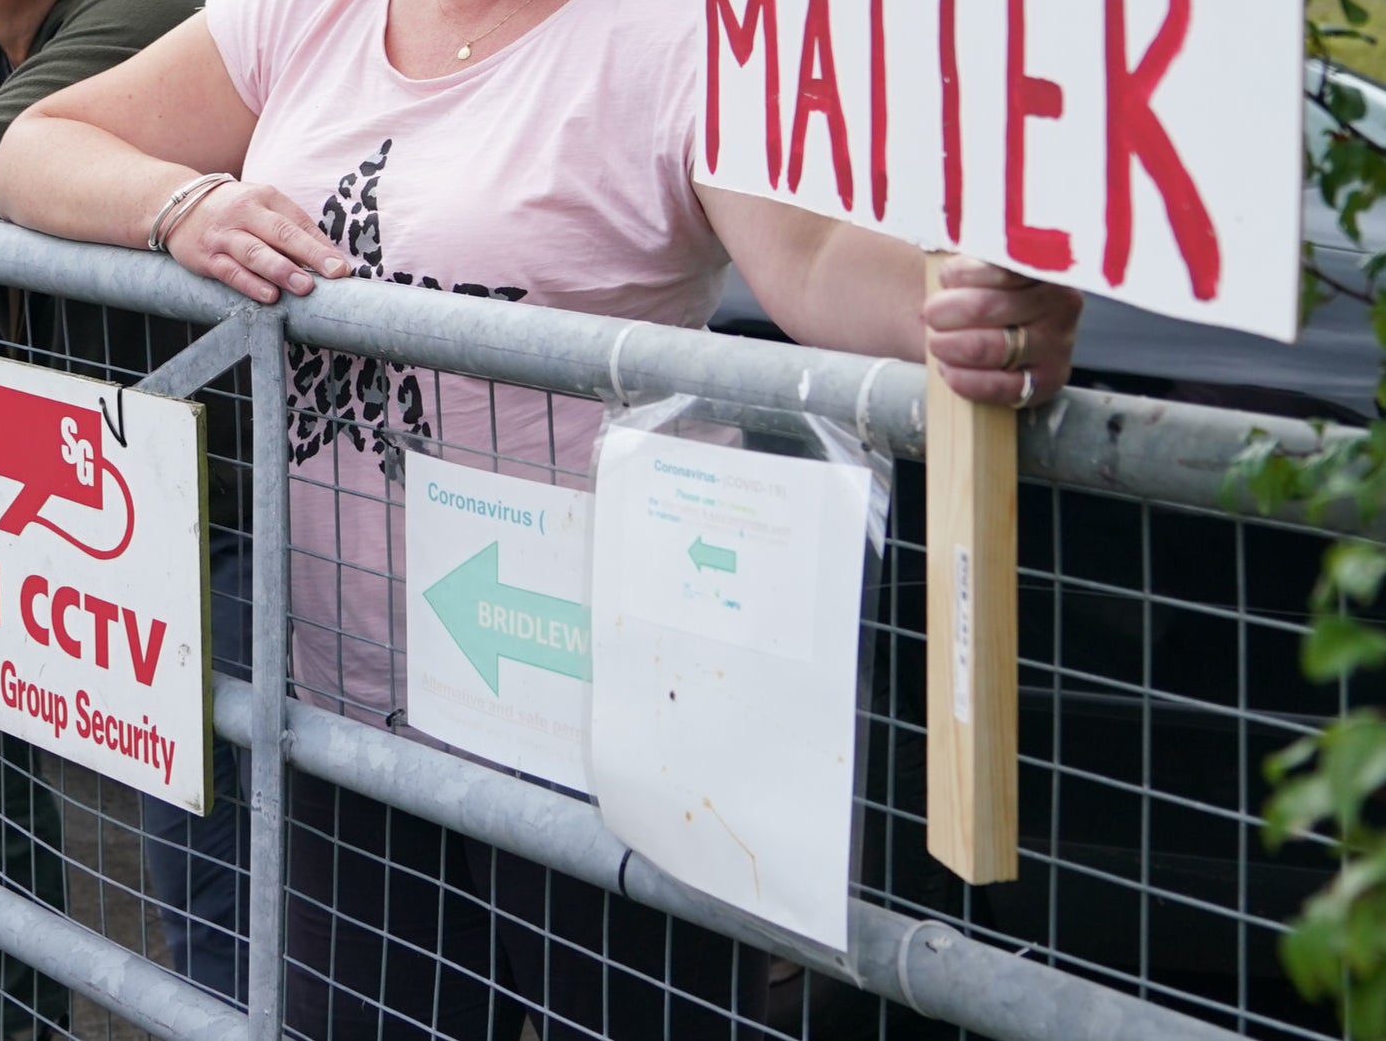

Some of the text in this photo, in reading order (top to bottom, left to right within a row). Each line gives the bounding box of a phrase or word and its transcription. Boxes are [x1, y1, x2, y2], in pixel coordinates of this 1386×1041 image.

[60, 416, 95, 487] SG
[428, 482, 533, 527] Coronavirus
[20, 574, 167, 687] CCTV
[1, 660, 68, 738] Group
[76, 688, 176, 786] Security
